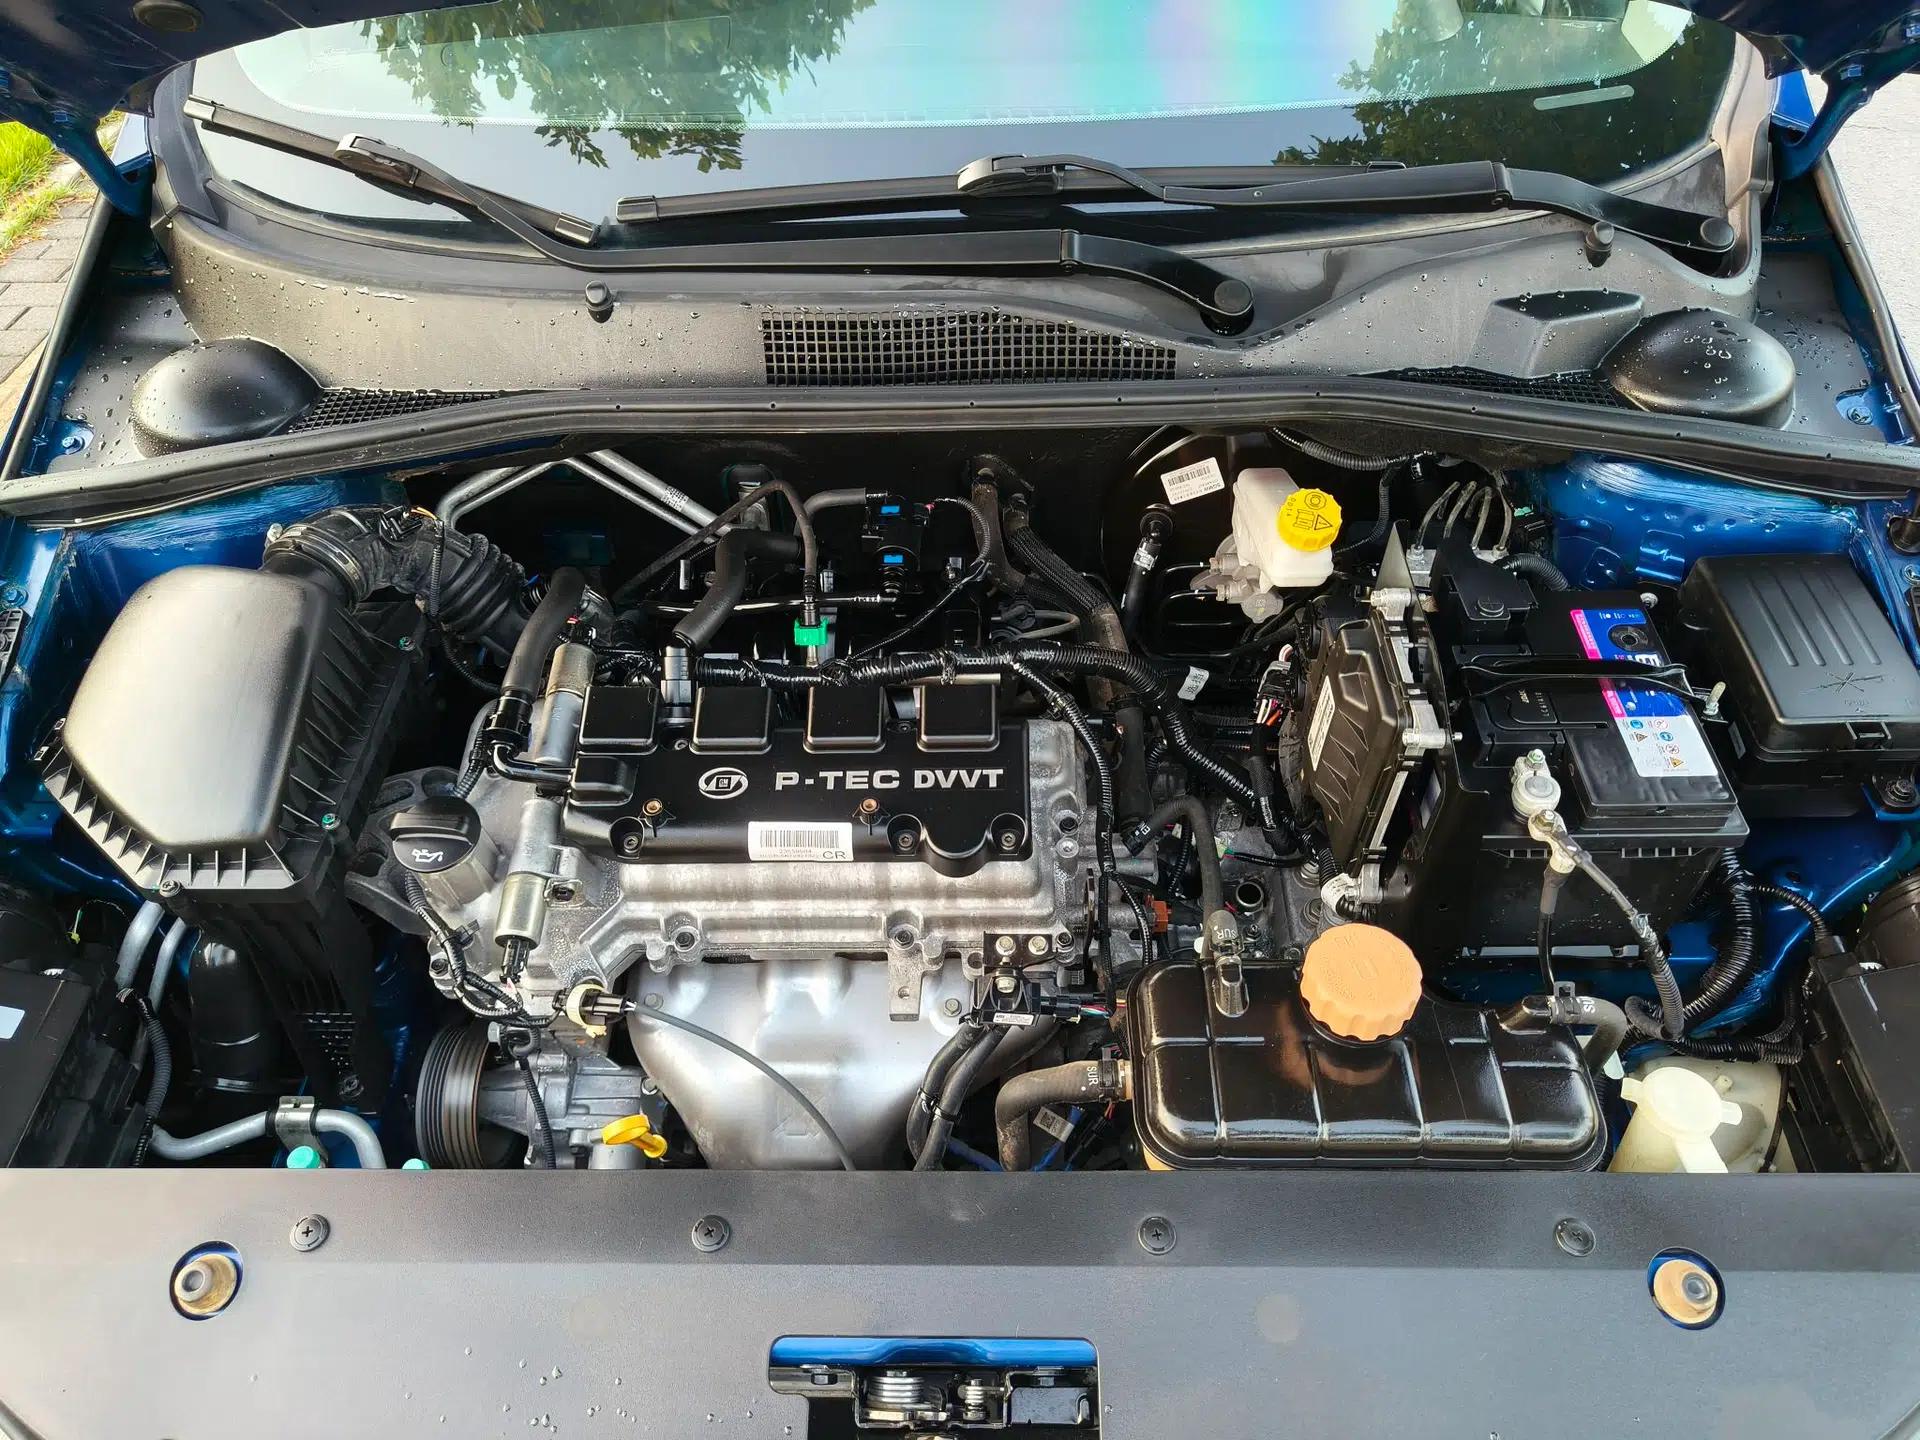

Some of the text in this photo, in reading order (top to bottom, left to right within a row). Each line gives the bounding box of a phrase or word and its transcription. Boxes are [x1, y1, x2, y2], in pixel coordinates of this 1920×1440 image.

[775, 769, 1004, 791] P-TEC DVVT
[822, 850, 847, 860] CR
[1216, 928, 1238, 940] SUR
[1087, 1066, 1099, 1086] SUR
